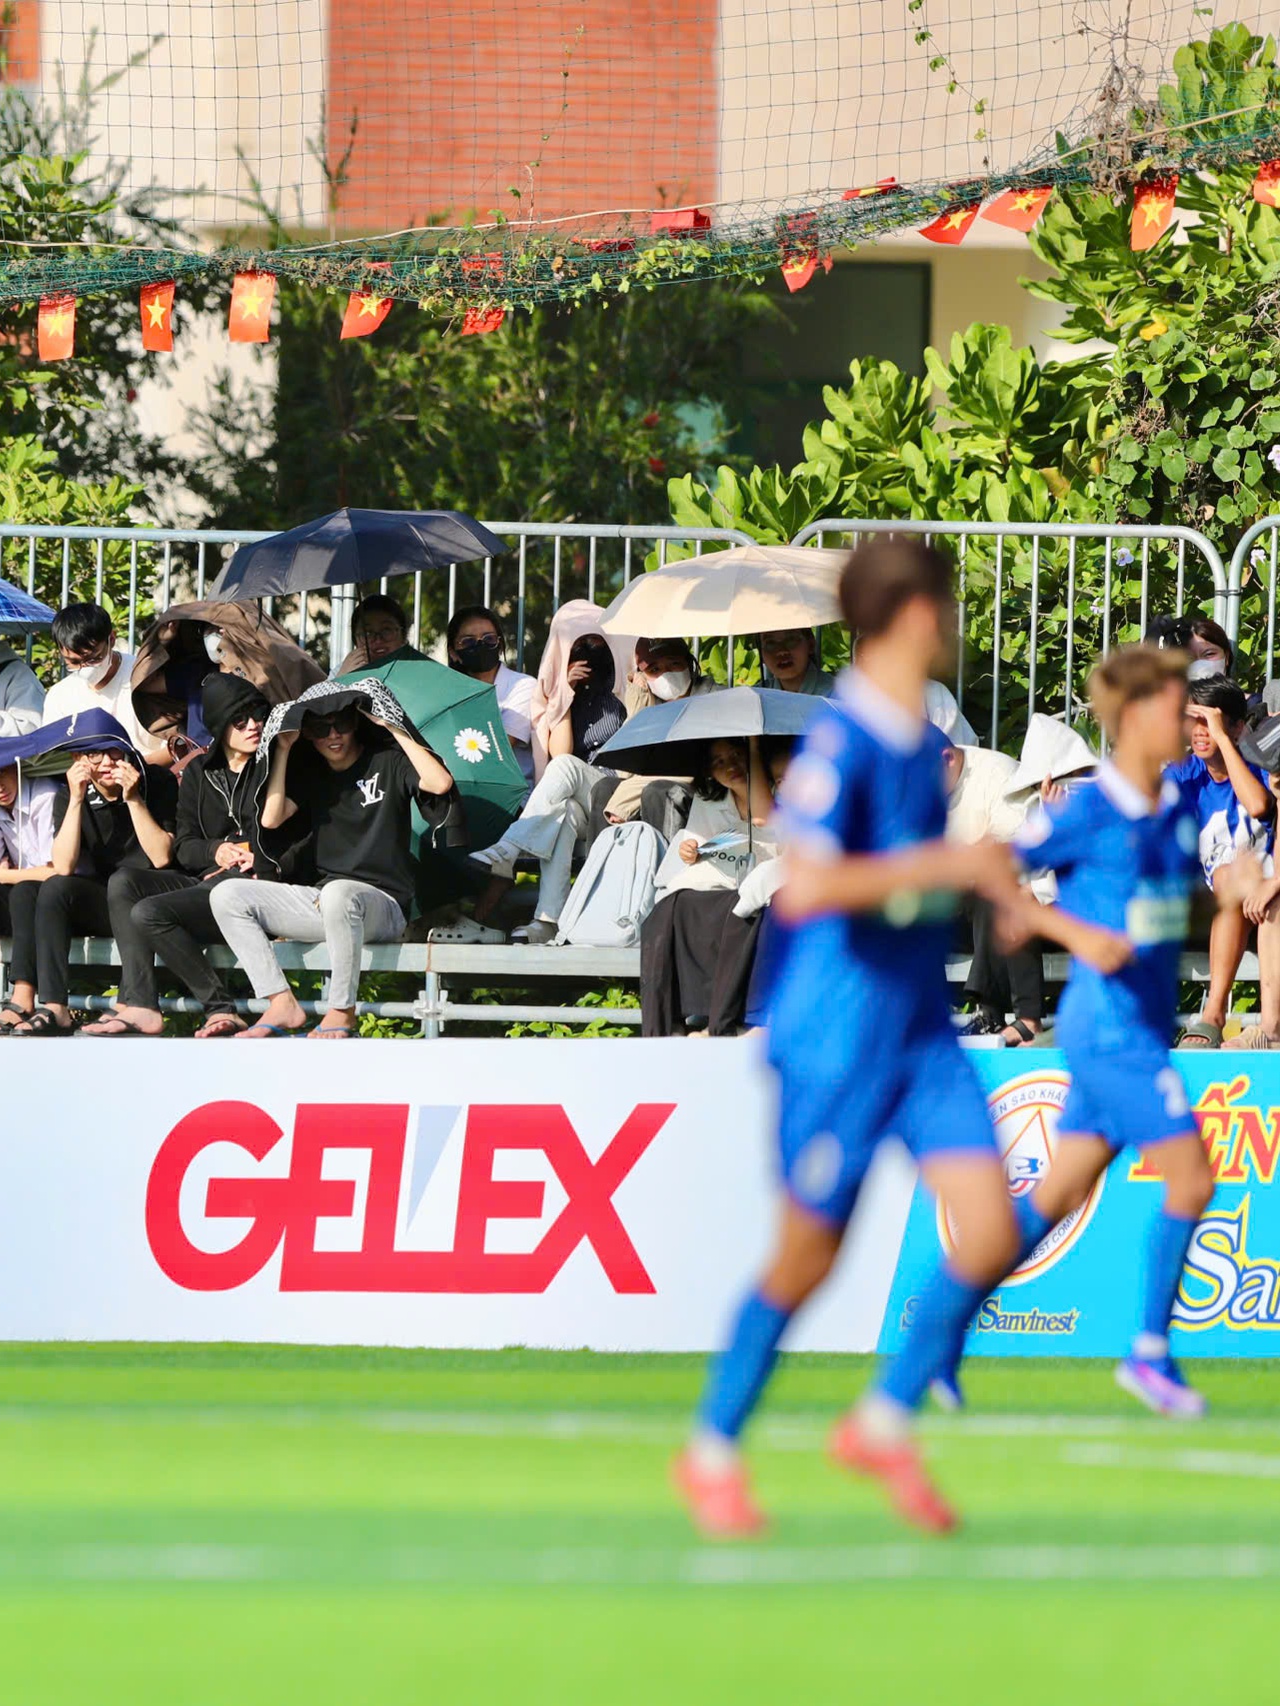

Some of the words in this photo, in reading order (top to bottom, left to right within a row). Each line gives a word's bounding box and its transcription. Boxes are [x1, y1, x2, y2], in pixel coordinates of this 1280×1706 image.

[1127, 1074, 1280, 1182] ẾN
[144, 1099, 678, 1295] GELEX
[976, 1295, 1081, 1334] Sanvinest
[1167, 1191, 1280, 1332] Sa
